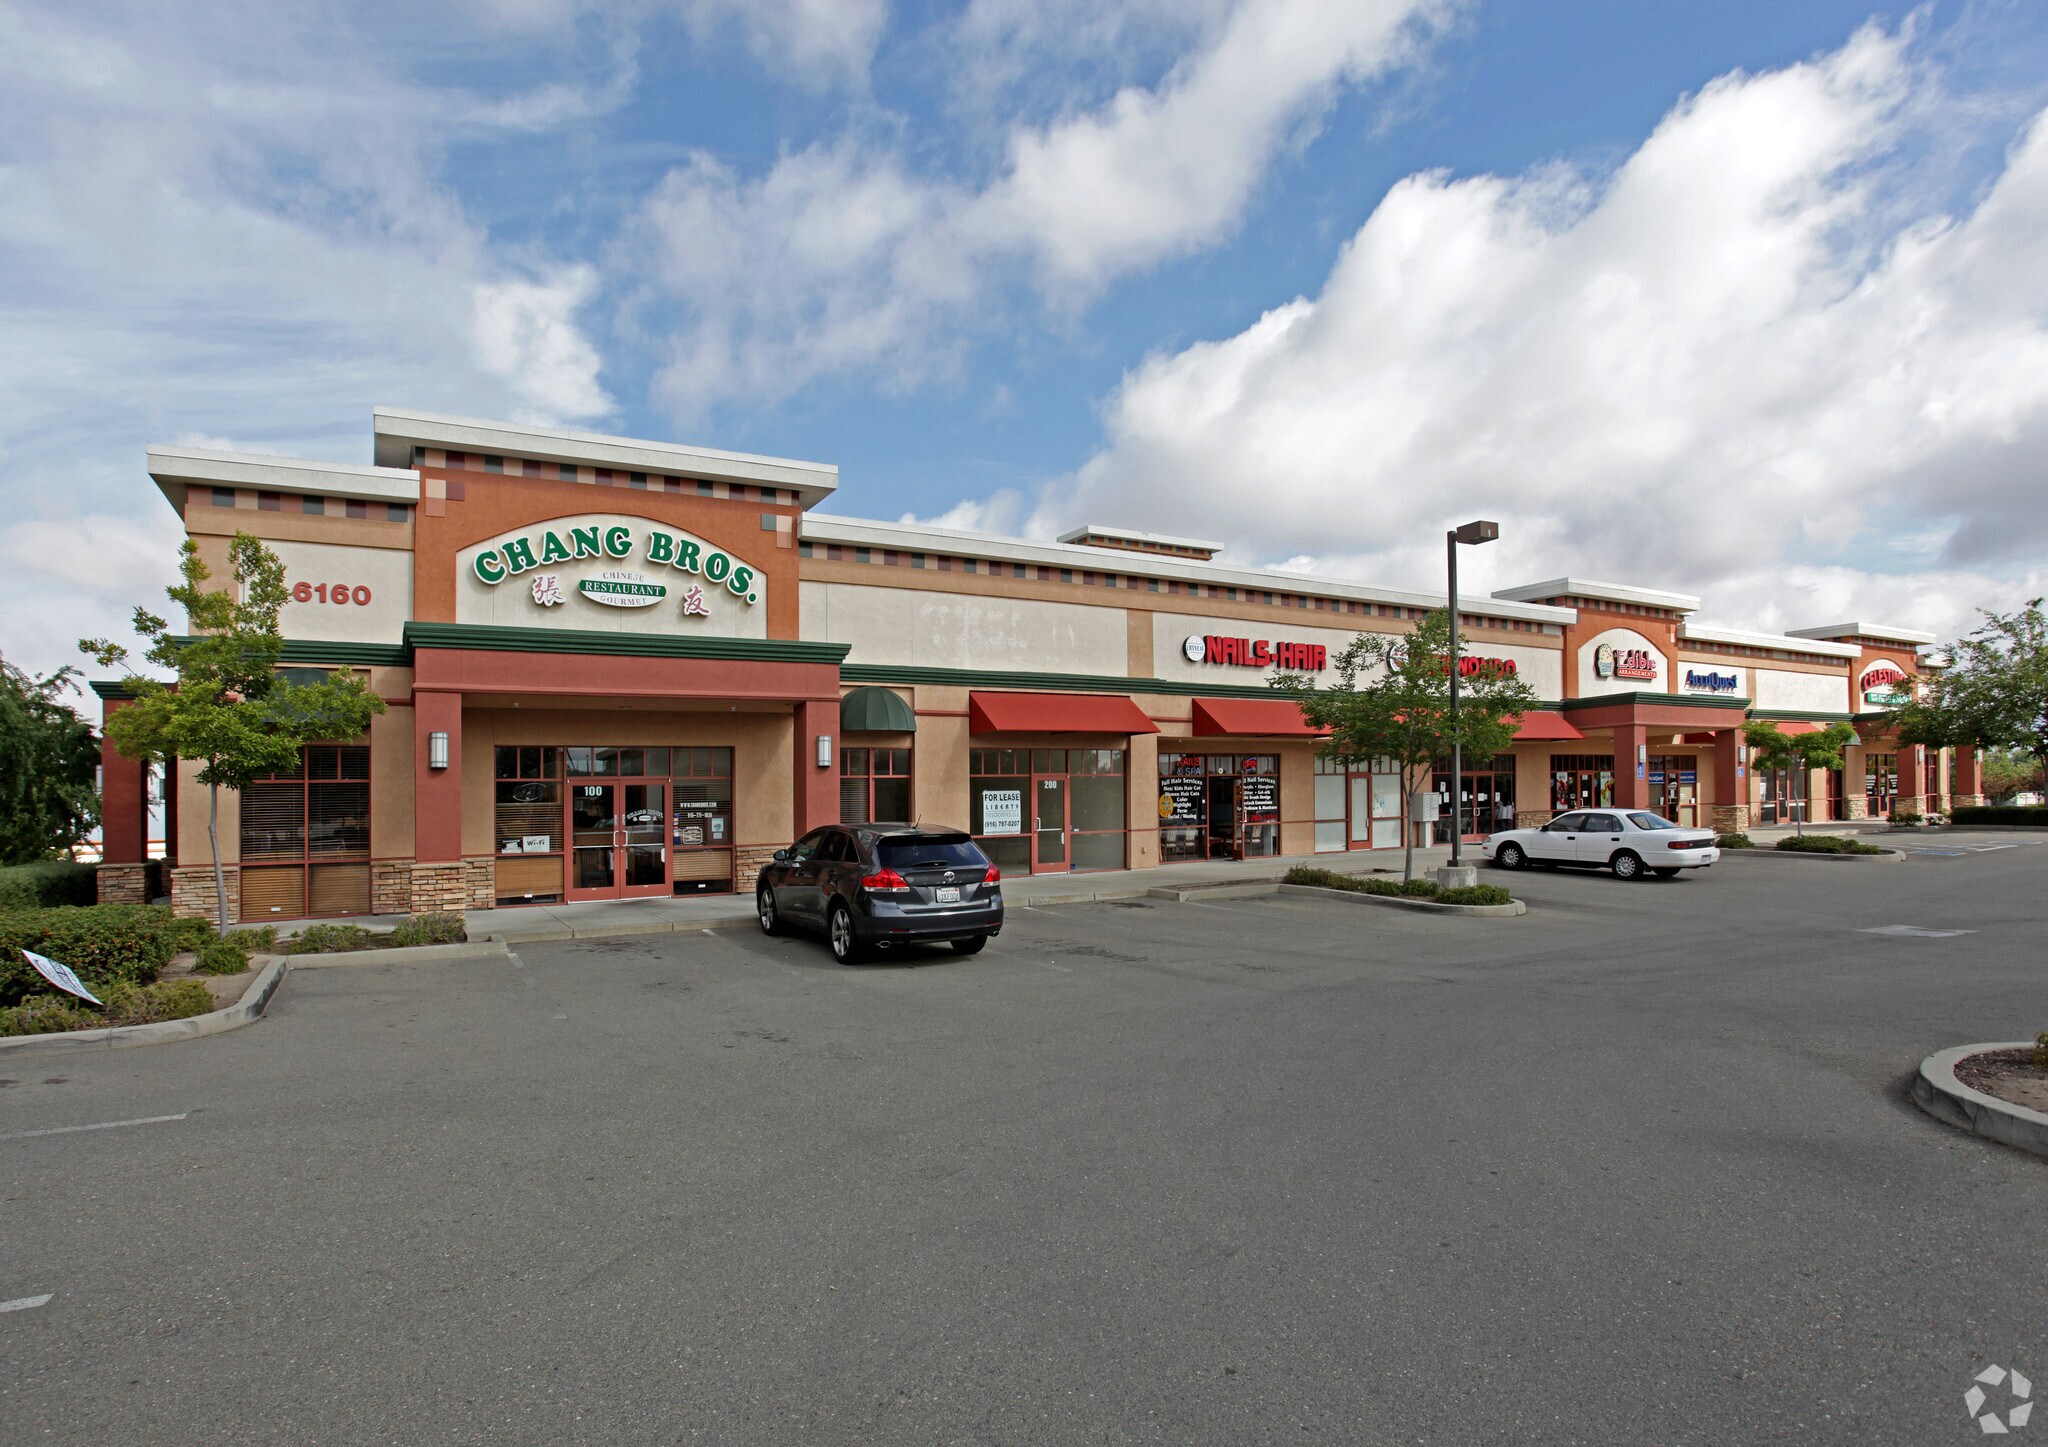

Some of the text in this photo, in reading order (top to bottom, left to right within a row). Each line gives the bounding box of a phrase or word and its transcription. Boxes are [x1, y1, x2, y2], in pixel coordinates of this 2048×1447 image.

[474, 526, 758, 604] CHANG BROS.
[602, 571, 645, 582] CHINESE
[292, 581, 372, 606] 6160
[532, 574, 567, 606] 張
[584, 580, 662, 597] RESTAURANT
[600, 594, 647, 606] GOURMET
[683, 584, 711, 616] 友
[1204, 635, 1327, 671] NAILS-HAIR
[1617, 649, 1657, 669] Edible
[1618, 669, 1657, 678] ARRANGEMENTS
[584, 786, 603, 796] 100
[1044, 780, 1057, 789] 200
[984, 793, 1020, 801] FOR LEASE
[526, 839, 546, 847] Wi-Fi
